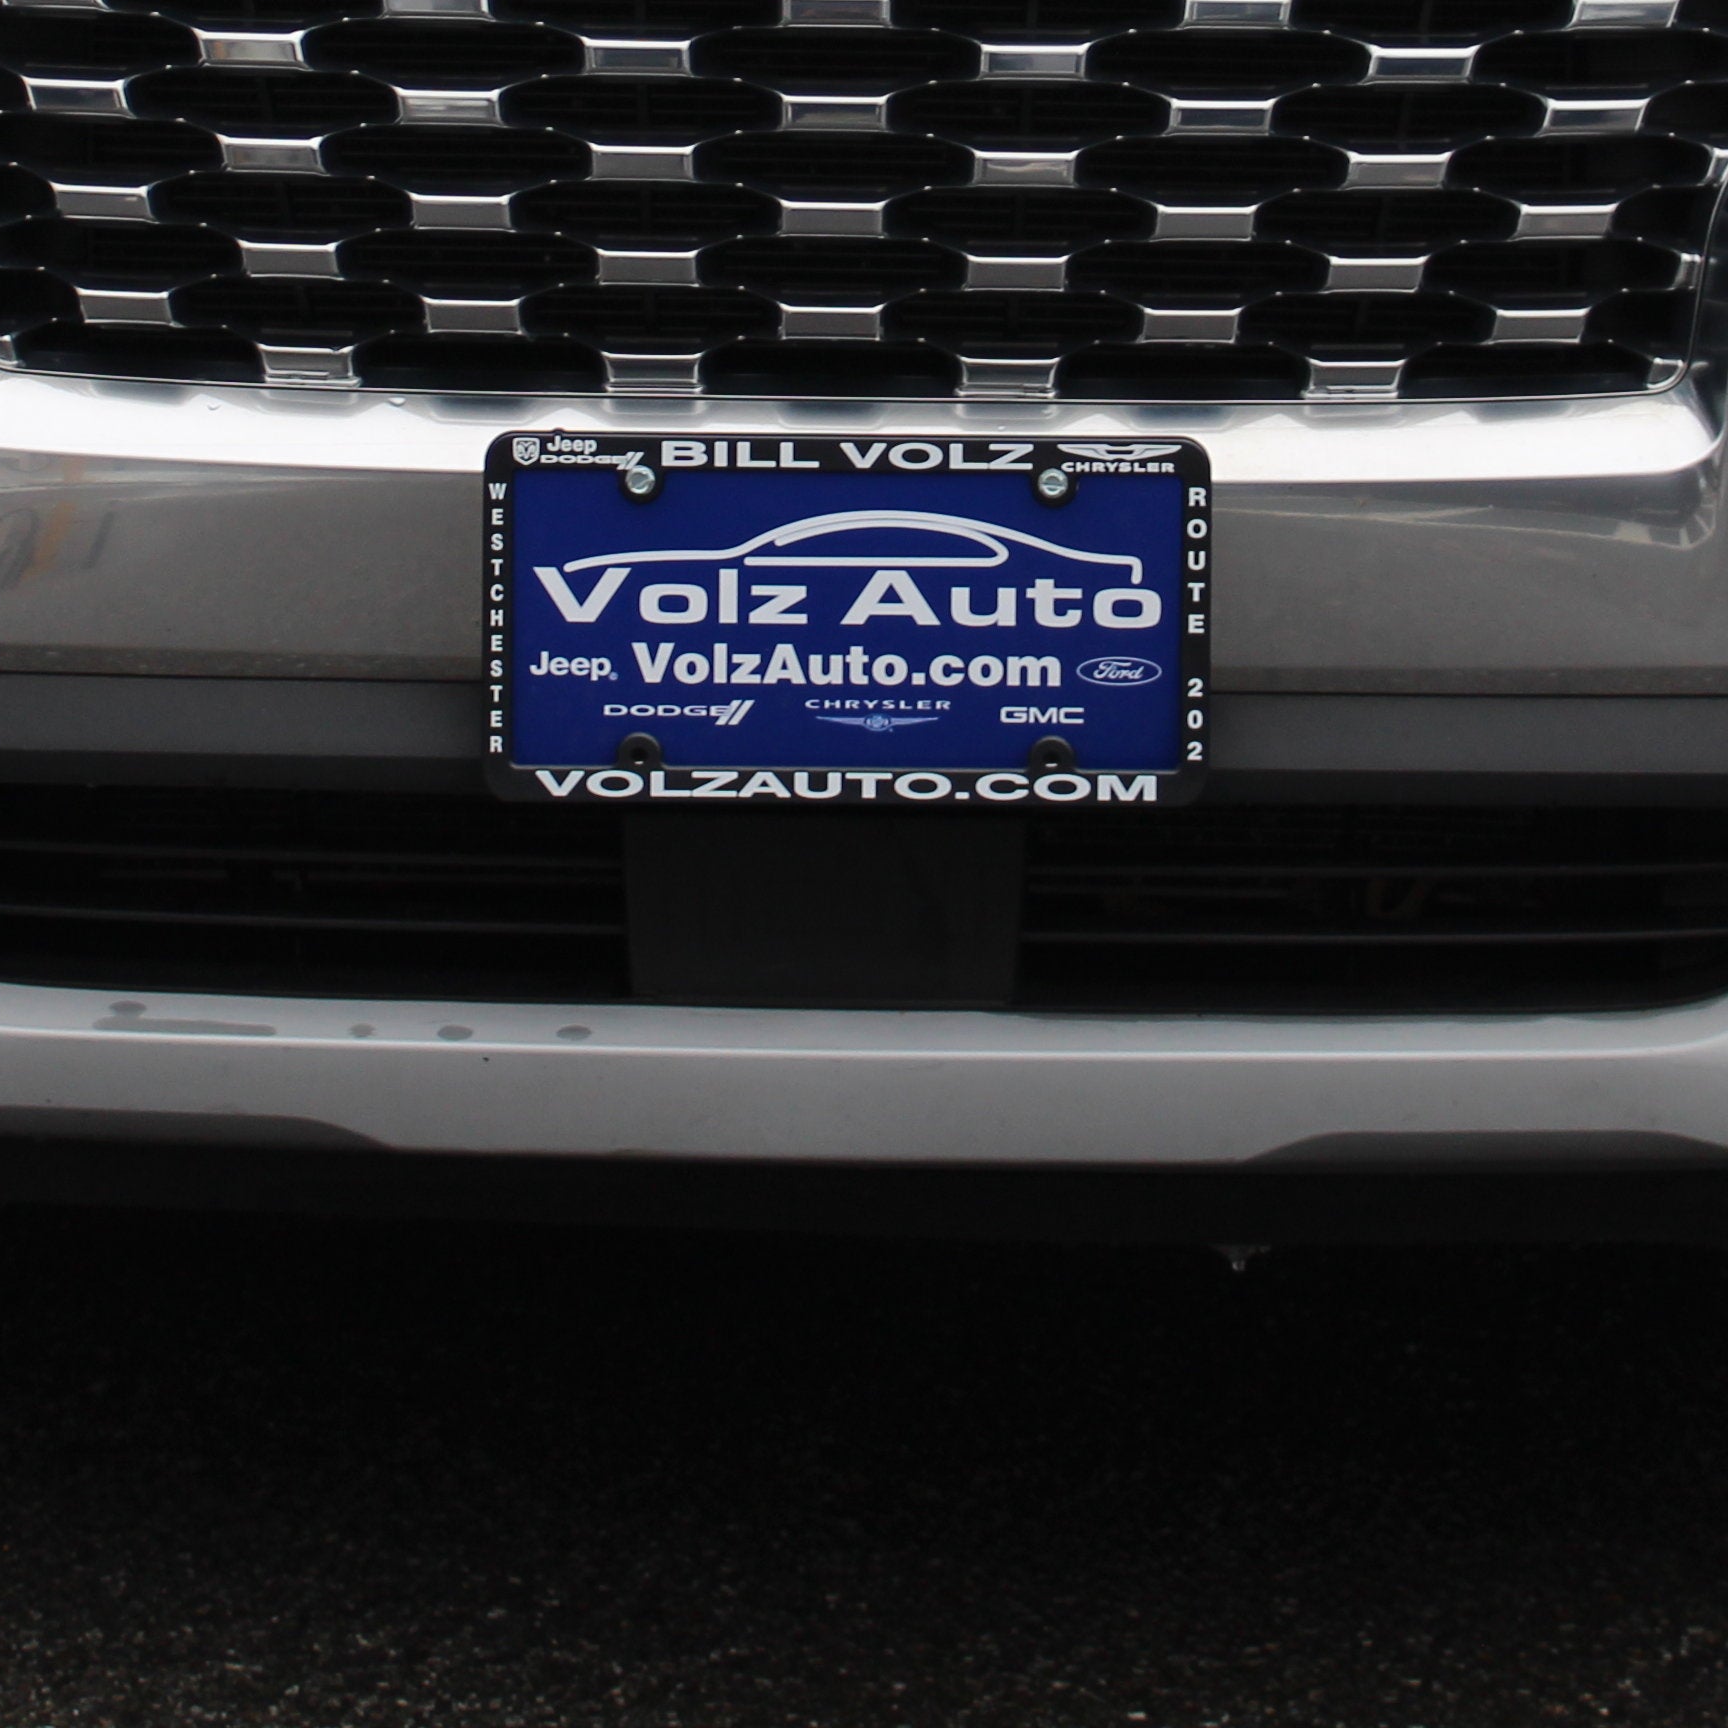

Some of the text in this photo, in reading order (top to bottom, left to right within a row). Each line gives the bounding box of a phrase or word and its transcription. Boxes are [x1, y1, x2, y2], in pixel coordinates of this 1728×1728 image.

[546, 435, 598, 455] Jeep
[661, 440, 1034, 470] BILL VOLZ
[1060, 461, 1175, 473] CHRYSLER
[532, 567, 1162, 629] Volz Auto
[488, 483, 507, 753] WESTCHESTER
[1186, 487, 1208, 761] ROUTE 202
[529, 651, 613, 681] Jeep
[631, 642, 1062, 687] VolzAuto.com
[1093, 661, 1144, 681] Ford
[603, 704, 730, 717] DODGE
[804, 699, 952, 711] CHRYSLER
[1000, 706, 1085, 725] GMC
[535, 770, 1158, 802] VOLZAUTO.COM
